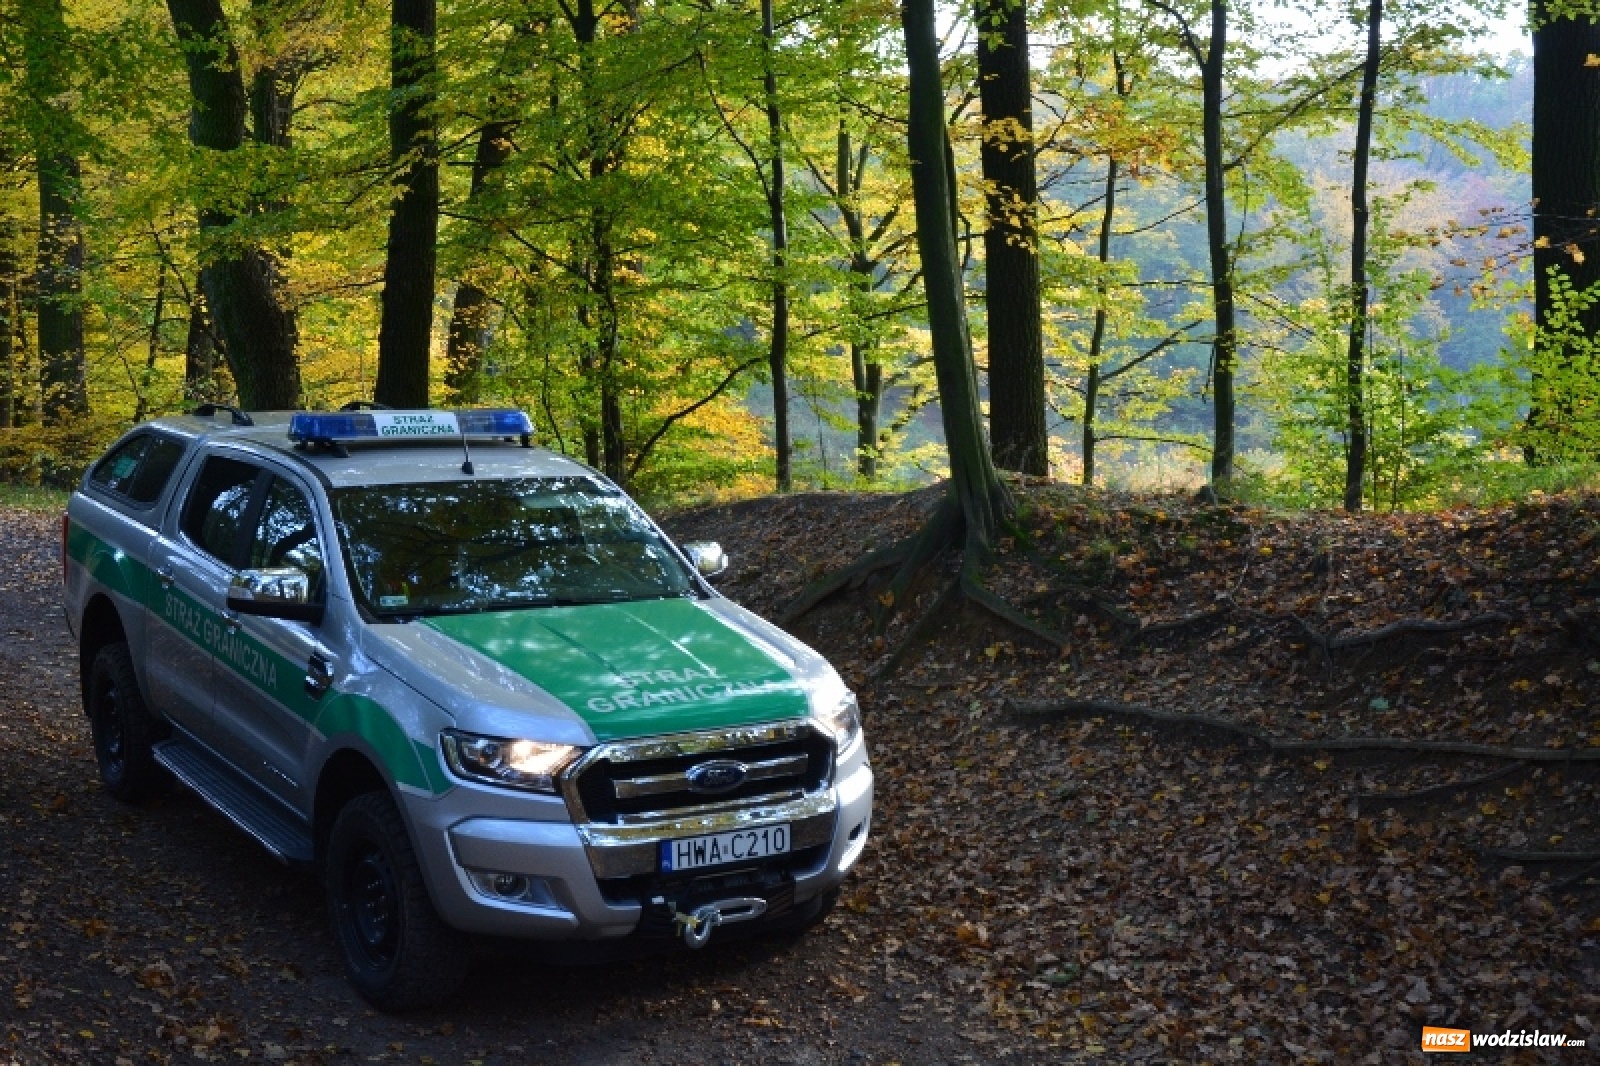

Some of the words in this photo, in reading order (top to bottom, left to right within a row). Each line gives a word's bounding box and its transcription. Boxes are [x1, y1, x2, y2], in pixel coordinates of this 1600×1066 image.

[381, 425, 455, 436] GRANICZNA
[203, 618, 278, 690] GRANICZNA
[677, 838, 722, 868] HWA
[731, 827, 785, 859] C210
